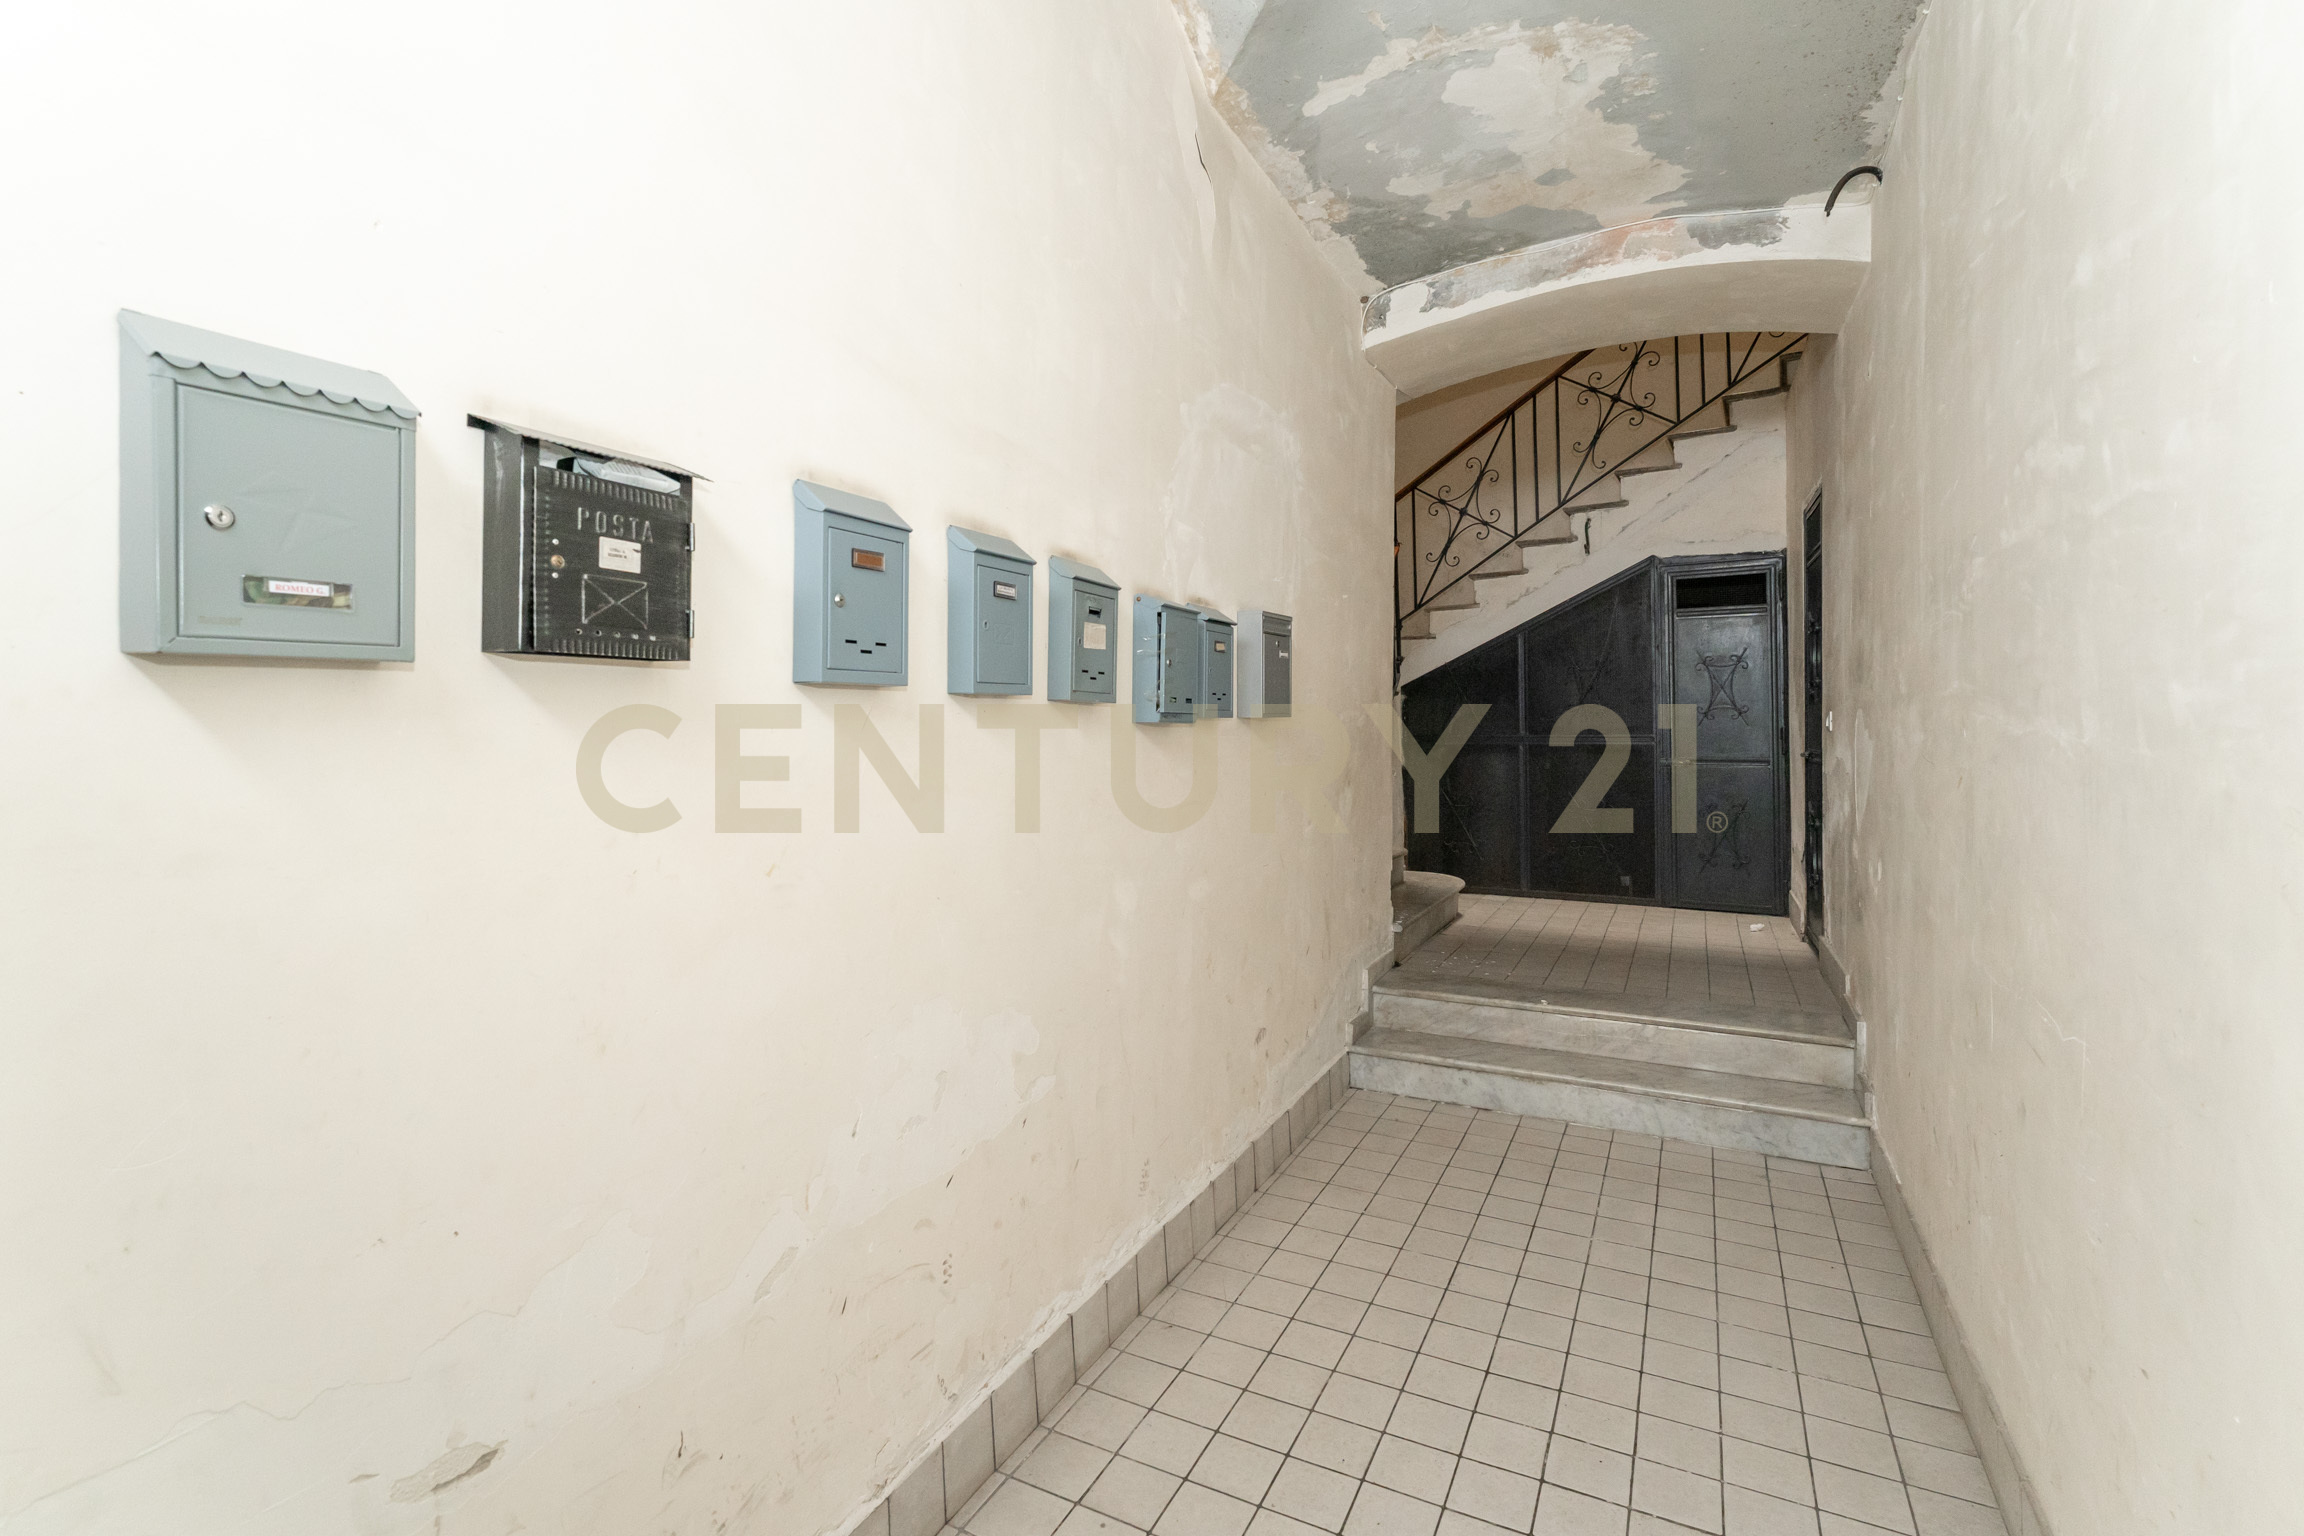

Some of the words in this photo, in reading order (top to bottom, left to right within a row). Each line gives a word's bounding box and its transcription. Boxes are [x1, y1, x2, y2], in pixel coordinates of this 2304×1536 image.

[577, 506, 654, 544] POSTA
[275, 584, 314, 594] ROMEO
[317, 587, 326, 595] G.
